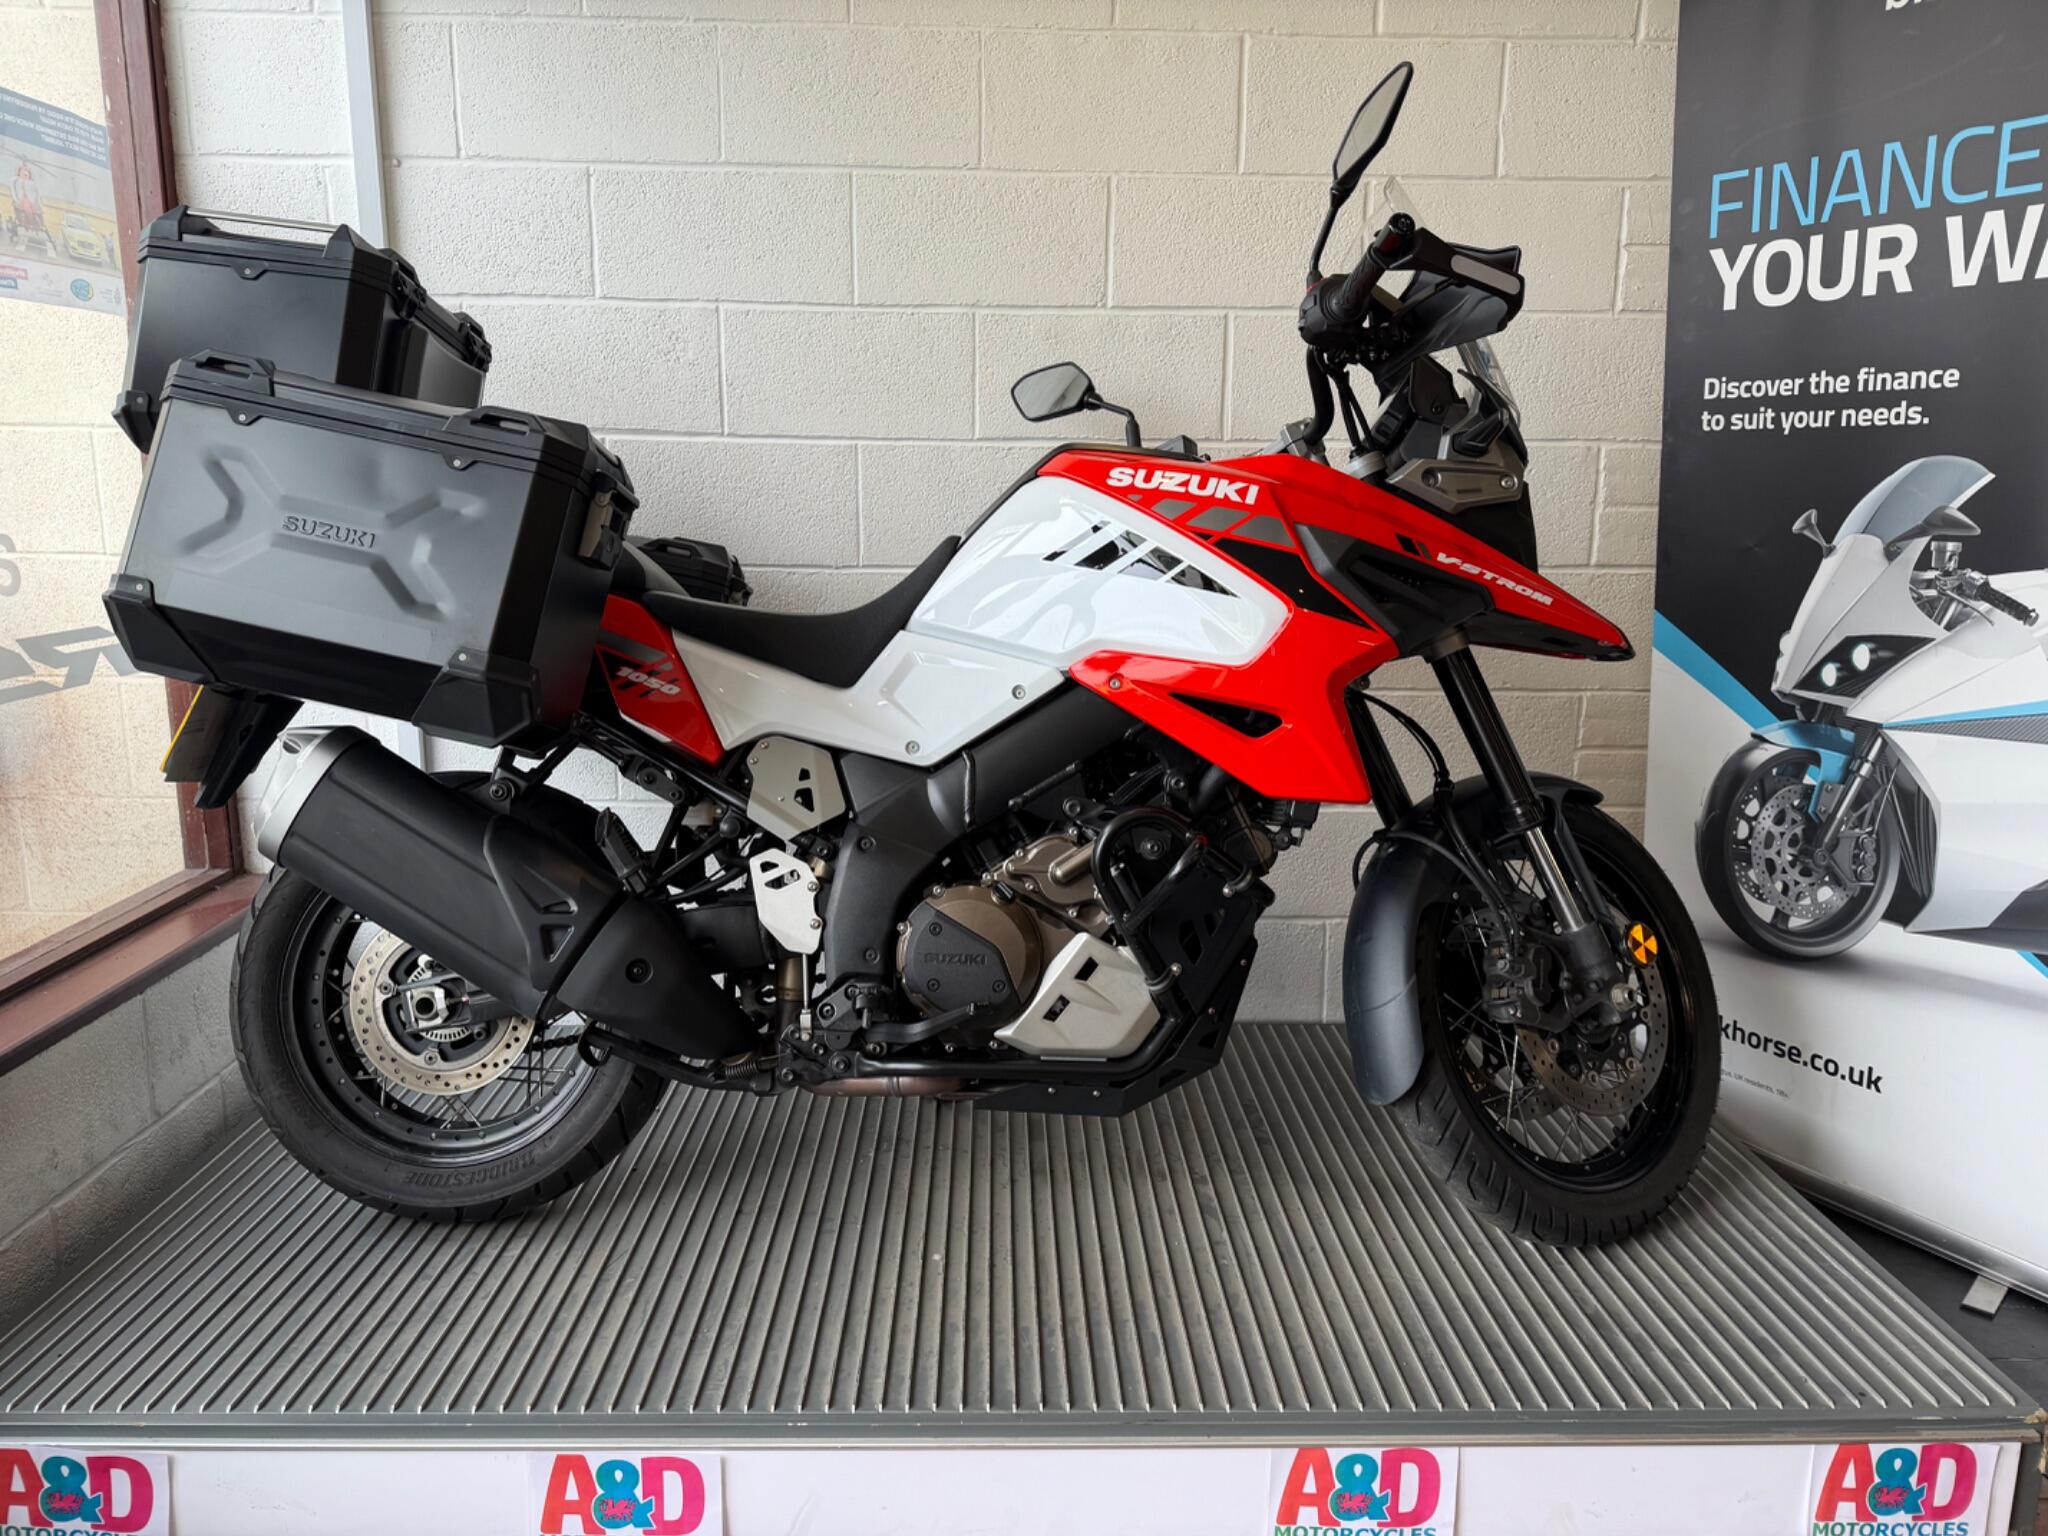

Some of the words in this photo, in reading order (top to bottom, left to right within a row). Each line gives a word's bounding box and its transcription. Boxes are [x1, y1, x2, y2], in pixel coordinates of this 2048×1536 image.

[1708, 113, 2048, 239] FINANCE
[1708, 222, 1919, 311] YOUR
[1945, 203, 2048, 288] W
[1703, 376, 1804, 400] Discover
[1809, 369, 1851, 395] the
[1857, 366, 1961, 392] finance
[1701, 411, 1725, 432] to
[1730, 406, 1775, 430] suit
[1780, 409, 1836, 436] your
[1841, 400, 1930, 427] needs.
[1105, 466, 1260, 506] SUZUKI
[282, 514, 377, 550] SUZUKI
[1436, 552, 1554, 606] V-STROM
[616, 665, 682, 696] 1050
[922, 951, 988, 967] SUZUKI
[1718, 1014, 1883, 1094] khorse.co.uk
[402, 1150, 536, 1187] BRIDGESTONE
[0, 1448, 153, 1533] A&D
[541, 1454, 705, 1535] A&D
[1276, 1447, 1441, 1527] A&D
[1815, 1442, 1977, 1521] A&D
[1812, 1522, 1969, 1536] MOTORCYCLES
